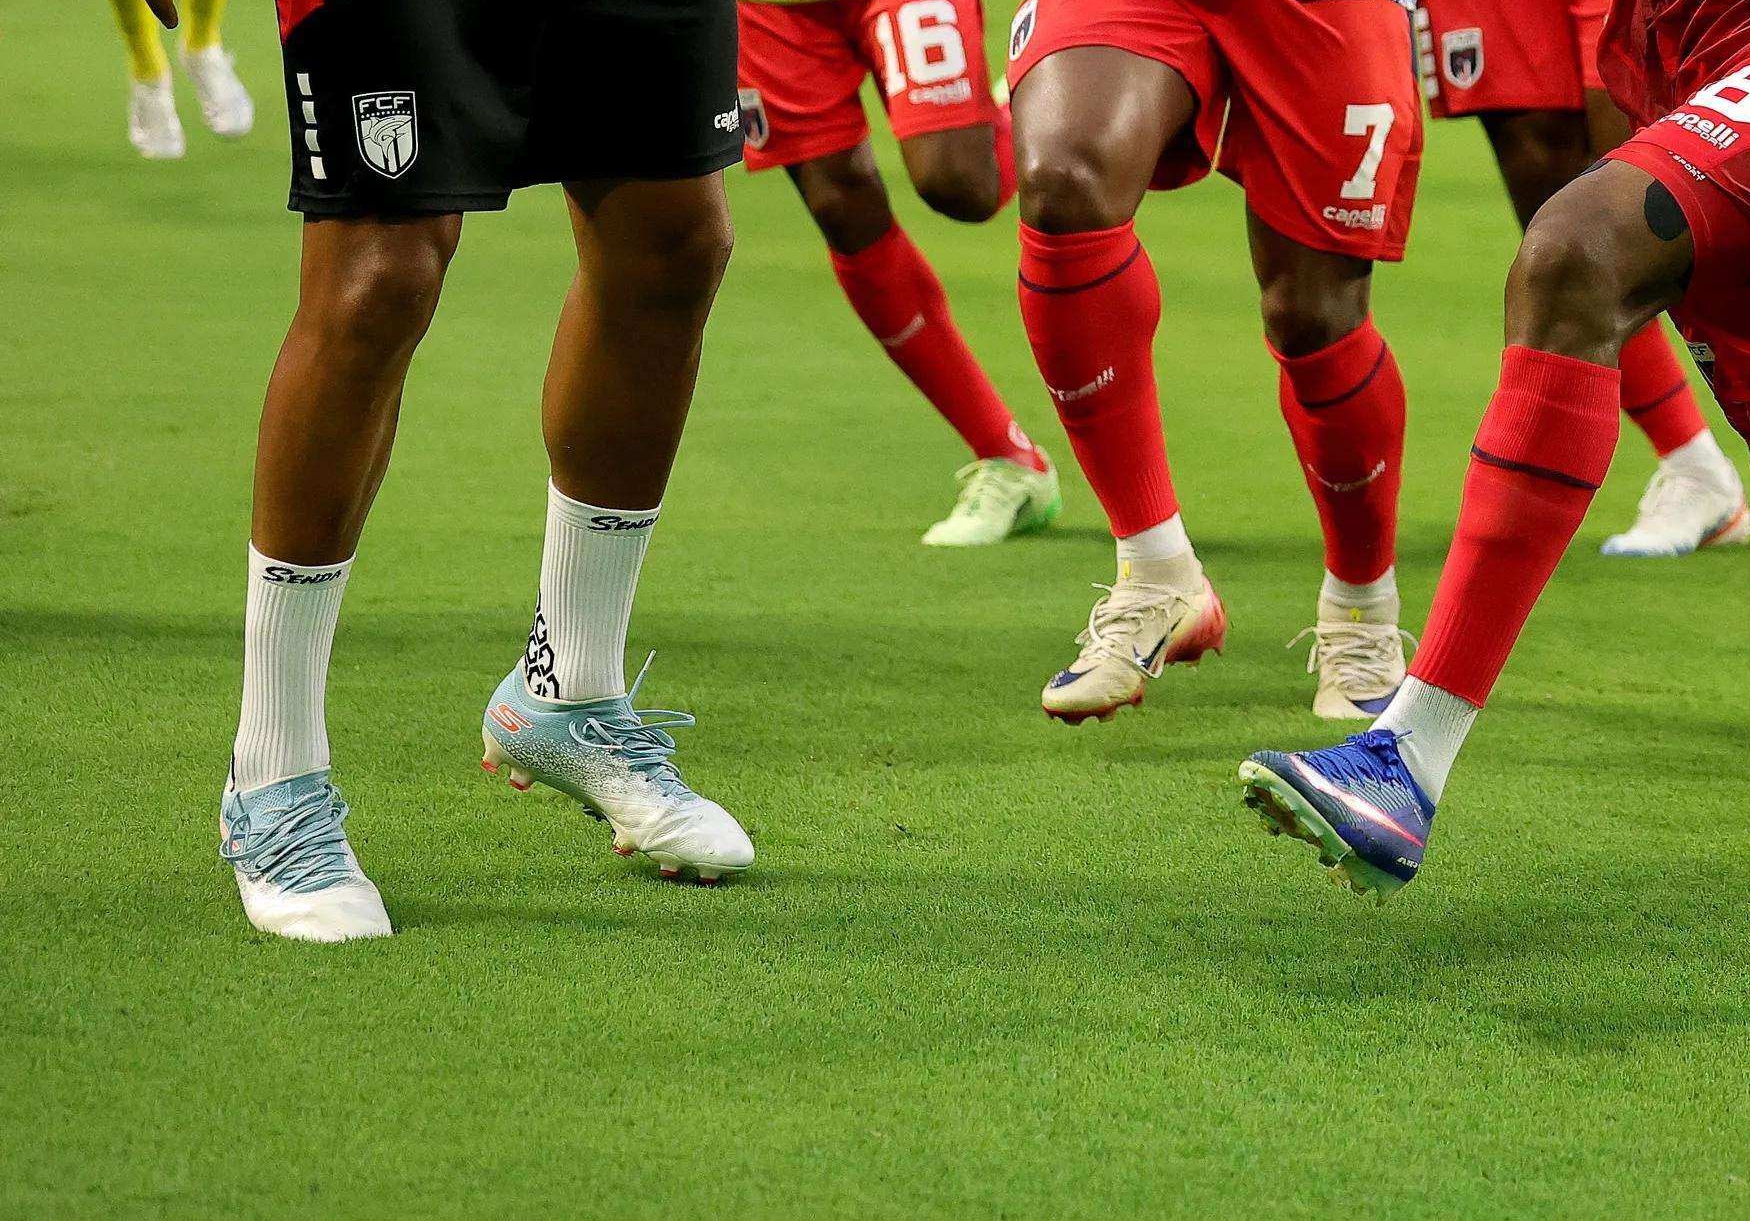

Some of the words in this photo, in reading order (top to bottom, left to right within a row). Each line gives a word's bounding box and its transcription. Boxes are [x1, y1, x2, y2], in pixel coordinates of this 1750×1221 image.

[359, 96, 411, 113] FCF
[1341, 104, 1395, 200] 7
[262, 566, 343, 585] SENDA
